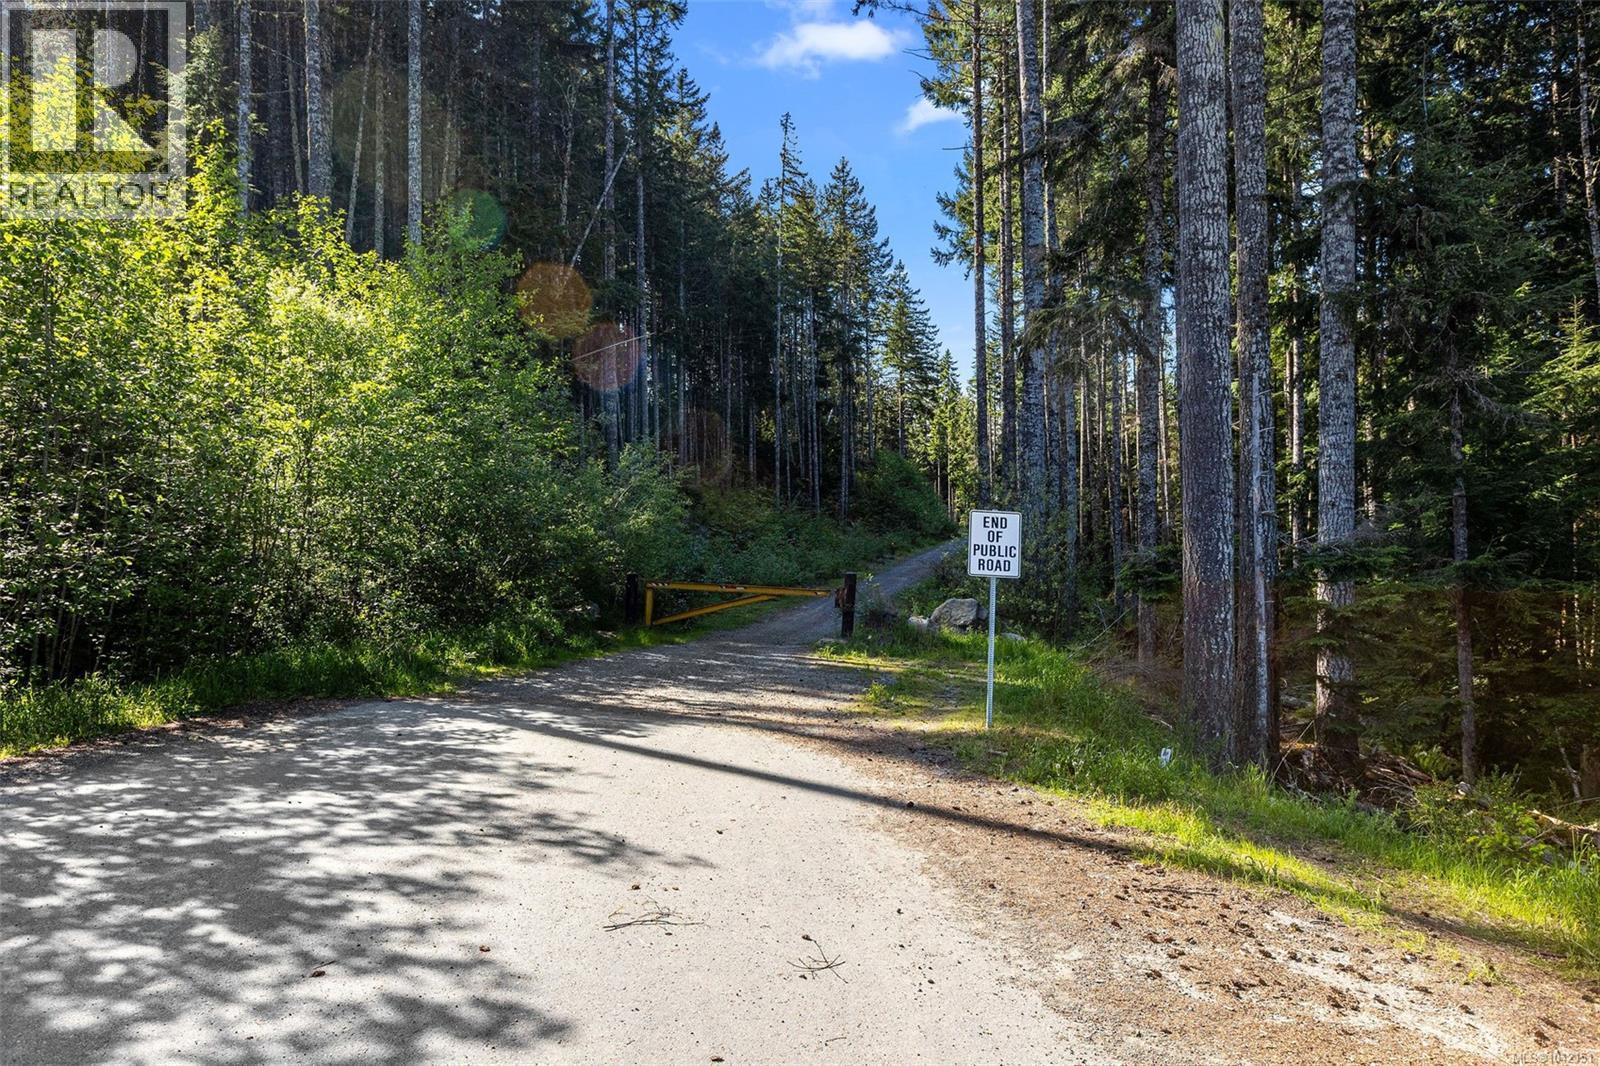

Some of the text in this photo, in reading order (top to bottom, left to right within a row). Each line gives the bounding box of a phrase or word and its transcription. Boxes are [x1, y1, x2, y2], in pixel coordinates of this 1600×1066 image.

[983, 516, 1008, 530] END
[987, 530, 1003, 543] OF
[973, 543, 1017, 558] PUBLIC
[978, 558, 1011, 572] ROAD
